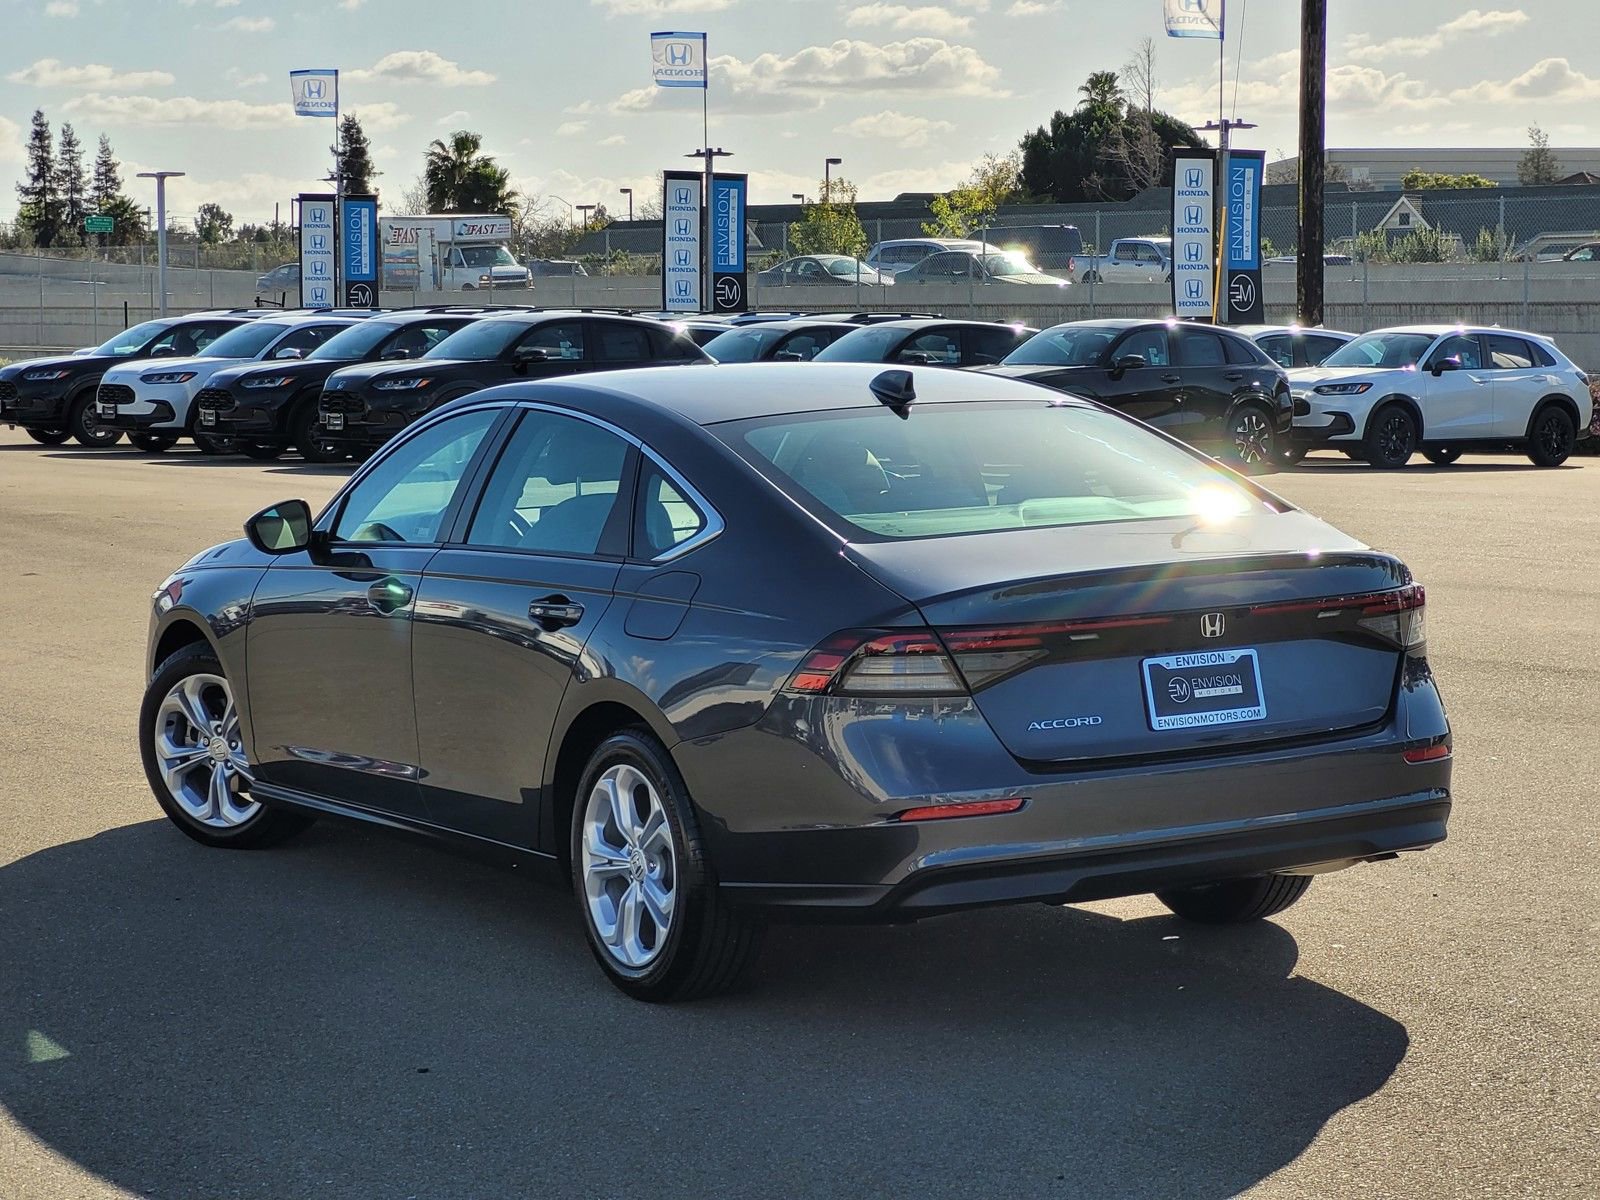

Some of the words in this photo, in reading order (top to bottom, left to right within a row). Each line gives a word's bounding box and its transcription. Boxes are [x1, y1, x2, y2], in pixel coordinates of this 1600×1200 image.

[1231, 167, 1245, 261] ENVISION
[468, 223, 497, 235] FAST
[717, 187, 729, 266] ENVISION
[350, 207, 361, 275] ENVISION
[1175, 652, 1225, 667] ENVISION
[1191, 674, 1242, 690] ENVISION
[1196, 687, 1239, 696] MOTORS
[1027, 716, 1102, 731] ACCORD
[1158, 708, 1261, 728] ENVISIONMOTORS.COM
